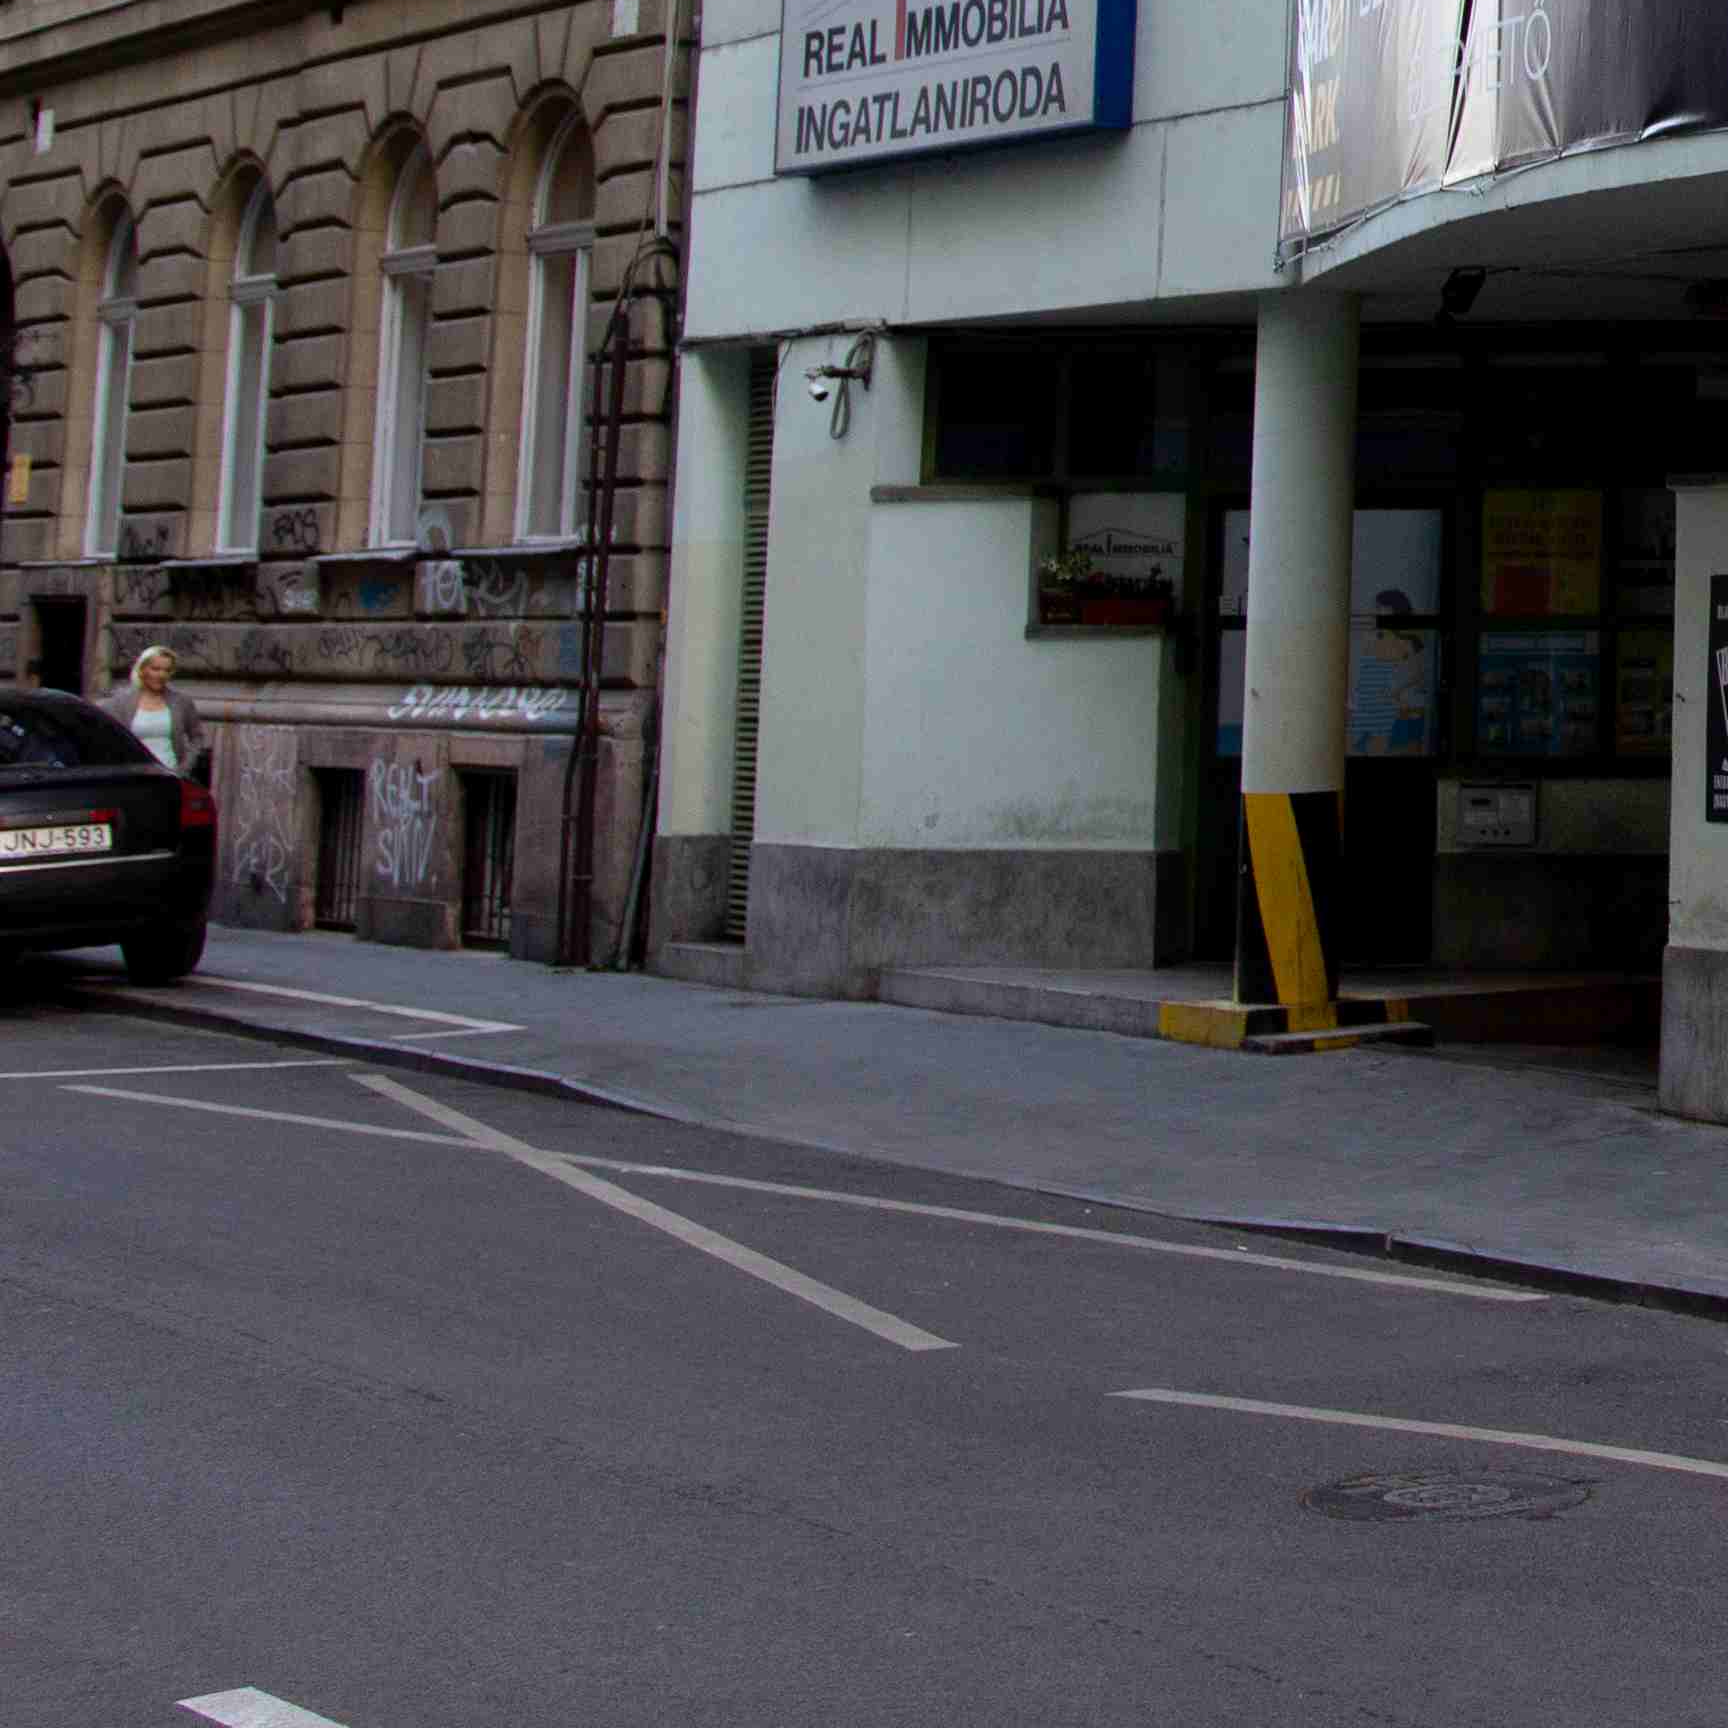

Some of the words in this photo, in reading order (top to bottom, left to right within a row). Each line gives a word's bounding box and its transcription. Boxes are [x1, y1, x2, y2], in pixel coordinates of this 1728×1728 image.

[803, 18, 887, 79] REAL
[794, 61, 1067, 155] INGATLANIRODA
[4, 827, 104, 852] JNJ-593
